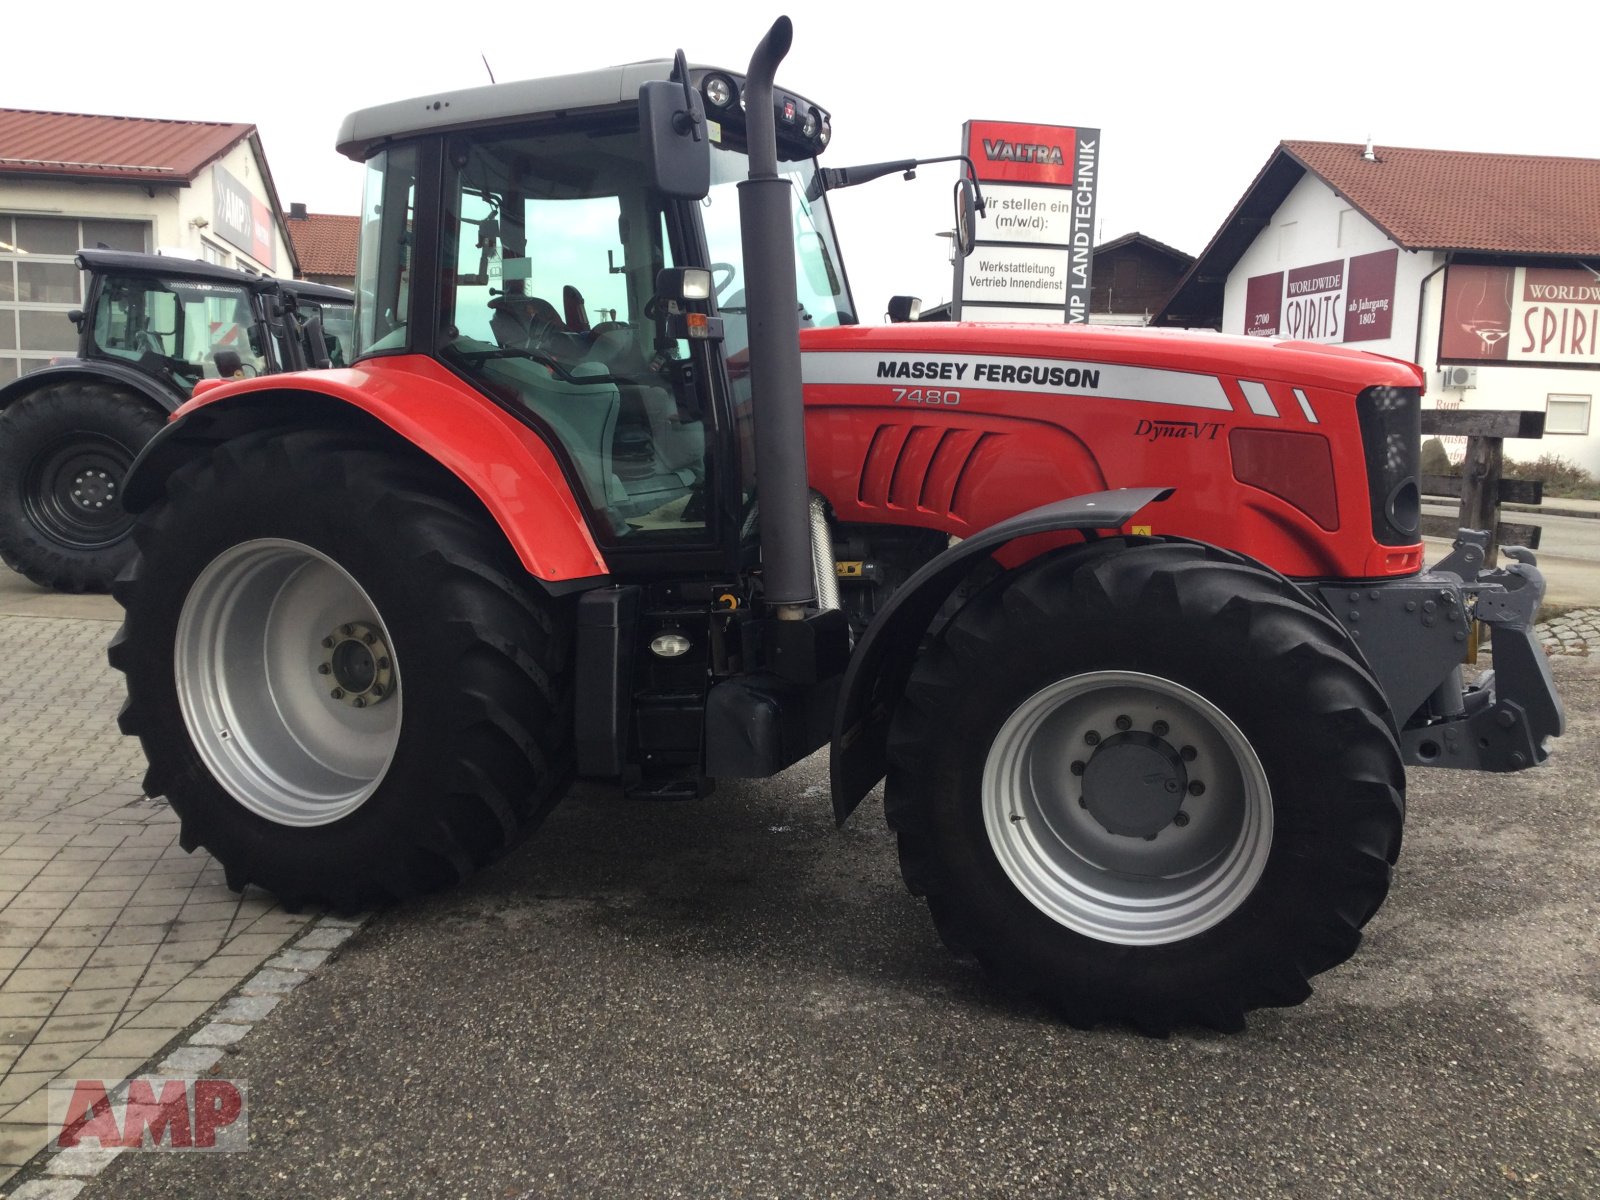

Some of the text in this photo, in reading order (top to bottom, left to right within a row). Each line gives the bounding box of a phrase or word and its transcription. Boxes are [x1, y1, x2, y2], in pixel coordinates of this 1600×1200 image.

[983, 139, 1064, 165] VALTRA
[225, 187, 244, 232] AMP
[1002, 198, 1046, 211] stellen
[1050, 201, 1069, 213] ein
[995, 214, 1048, 231] (m/w/d):
[1071, 140, 1096, 289] LANDTECHNIK
[979, 260, 1055, 277] Werkstattleitung
[970, 276, 1062, 290] Vertrieb Innendienst
[1289, 274, 1341, 294] WORLDWIDE
[1348, 298, 1389, 314] ab Jahrgang
[1254, 313, 1270, 326] 2700
[1286, 294, 1341, 339] SPIRITS
[1359, 313, 1376, 325] 1802
[1521, 306, 1599, 355] SPIRI
[876, 361, 1100, 389] MASSEY FERGUSON
[892, 388, 961, 405] 7480
[1435, 399, 1460, 410] Rum
